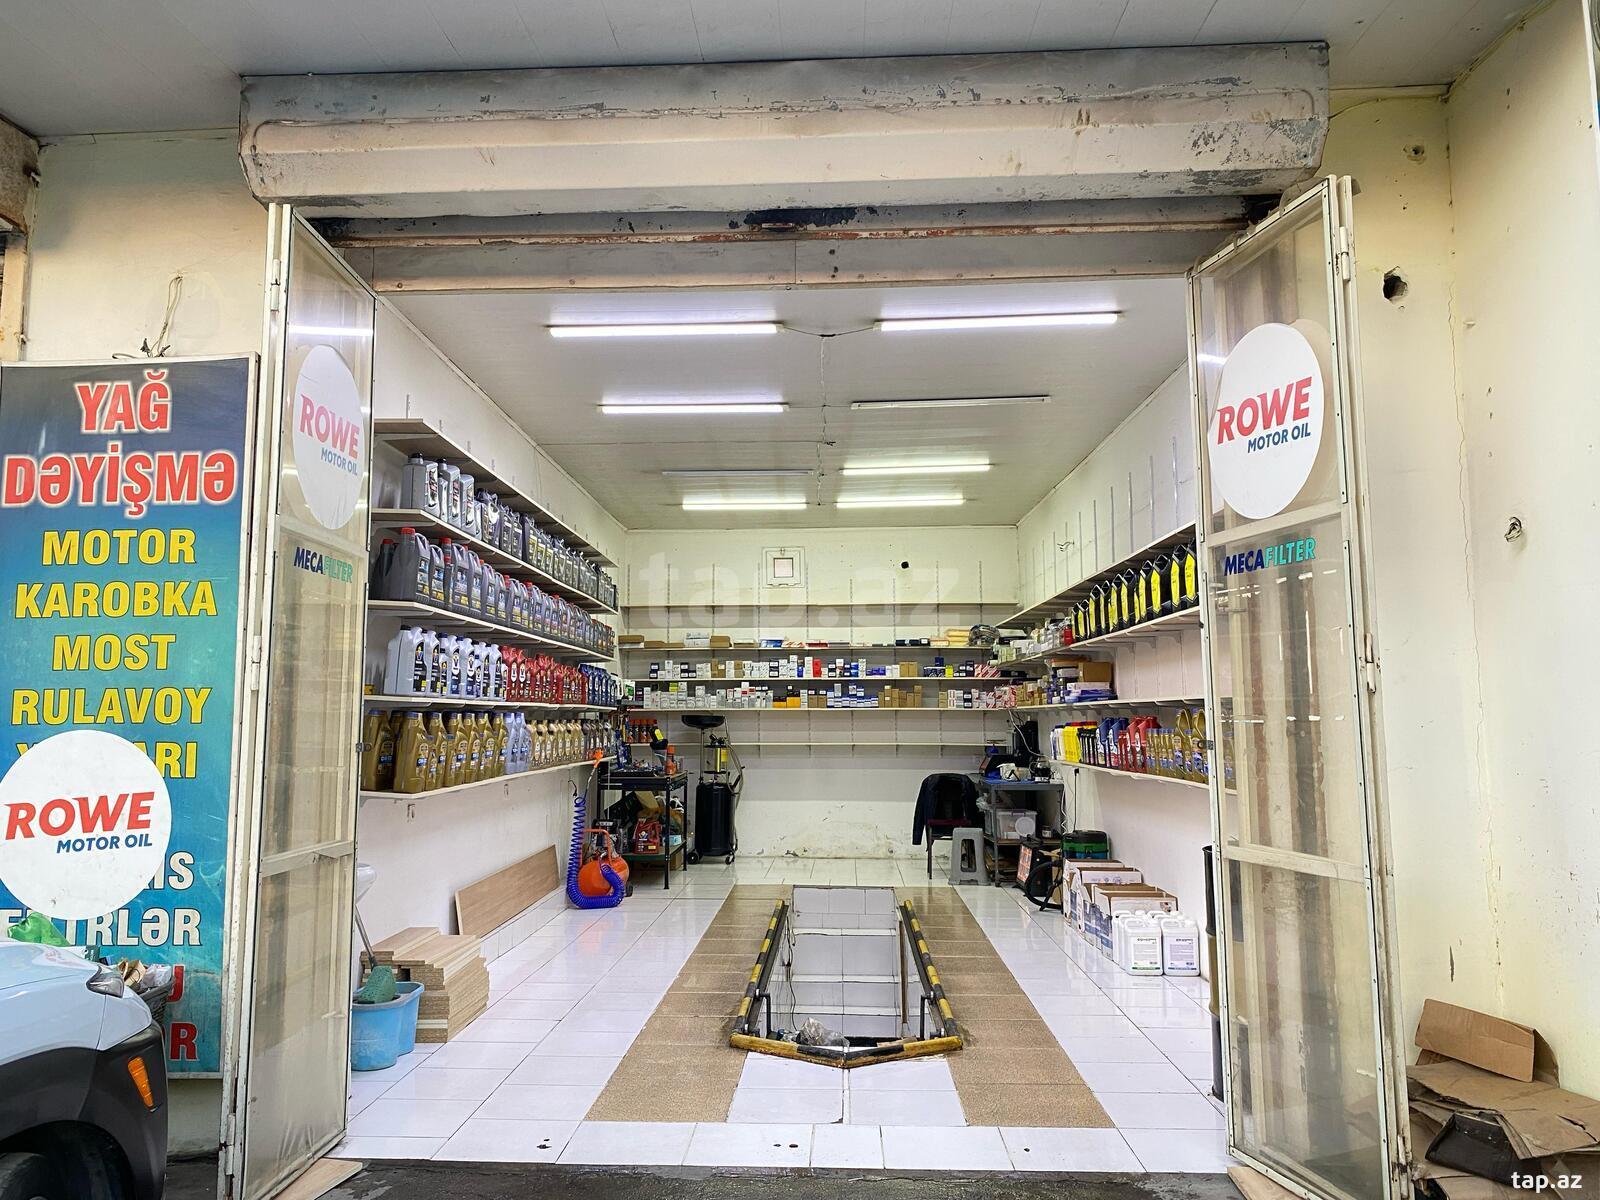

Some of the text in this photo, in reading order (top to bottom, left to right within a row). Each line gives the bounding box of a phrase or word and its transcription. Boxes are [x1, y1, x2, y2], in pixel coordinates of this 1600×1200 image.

[75, 369, 172, 433] YAĞ
[1216, 376, 1312, 445] ROWE
[300, 393, 360, 460] ROWE
[1247, 422, 1311, 453] MOTOR OIL
[2, 442, 237, 518] DƏYİŞMƏ
[321, 447, 358, 477] MOTOR OIL
[42, 528, 197, 566] MOTOR
[293, 546, 354, 584] MECAFILTER
[1223, 537, 1317, 577] MECAFILTER
[14, 580, 218, 619] KAROBKA
[51, 633, 177, 672] MOST
[11, 686, 213, 726] RULAVOY
[4, 791, 155, 841] ROWE
[56, 833, 153, 854] MOTOR OIL
